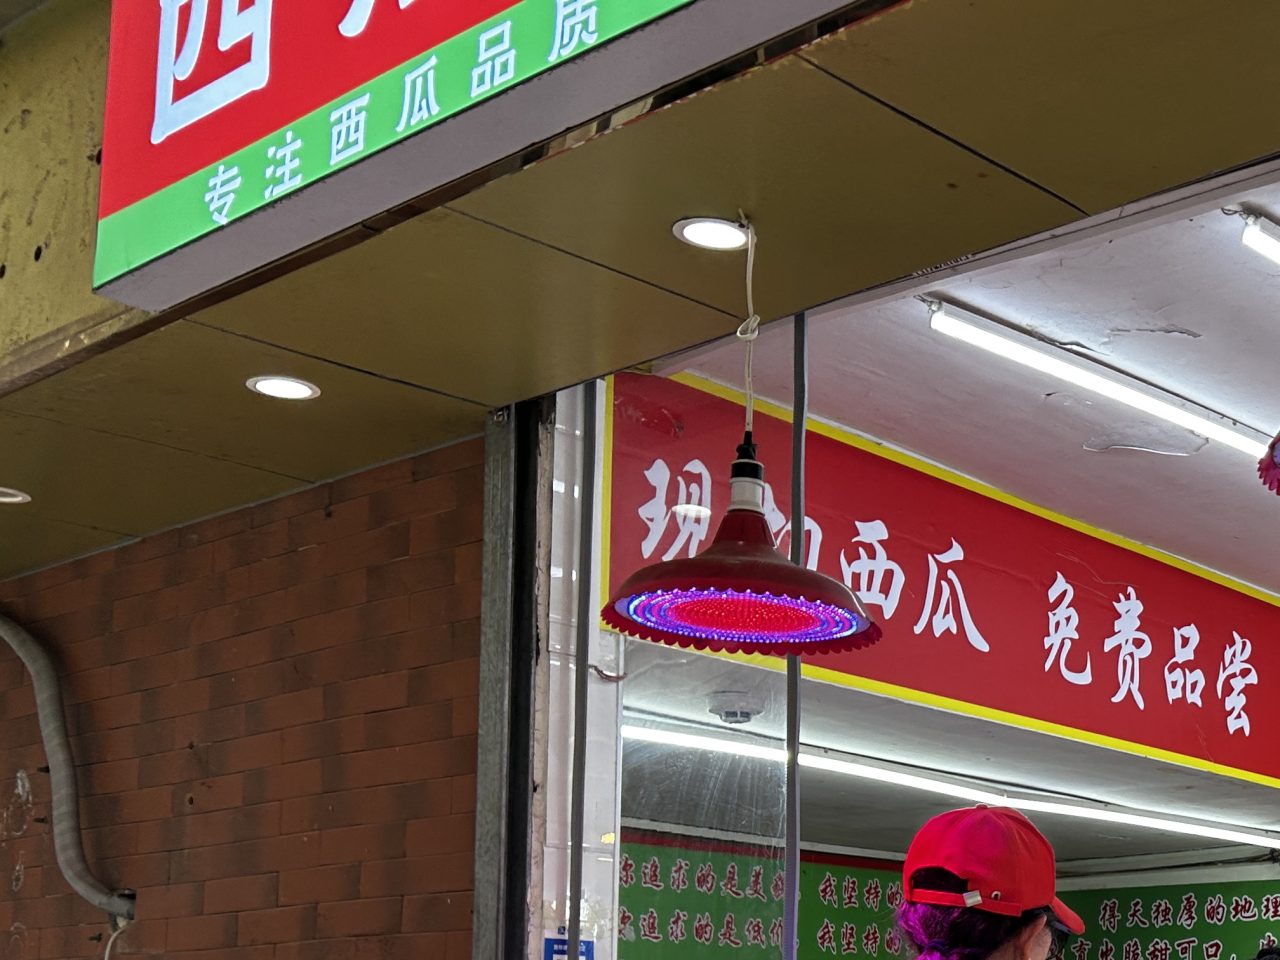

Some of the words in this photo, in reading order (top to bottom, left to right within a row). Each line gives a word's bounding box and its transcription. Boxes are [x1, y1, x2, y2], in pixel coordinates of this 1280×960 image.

[202, 0, 598, 225] 专注西瓜品质
[1043, 572, 1259, 737] 免费品尝
